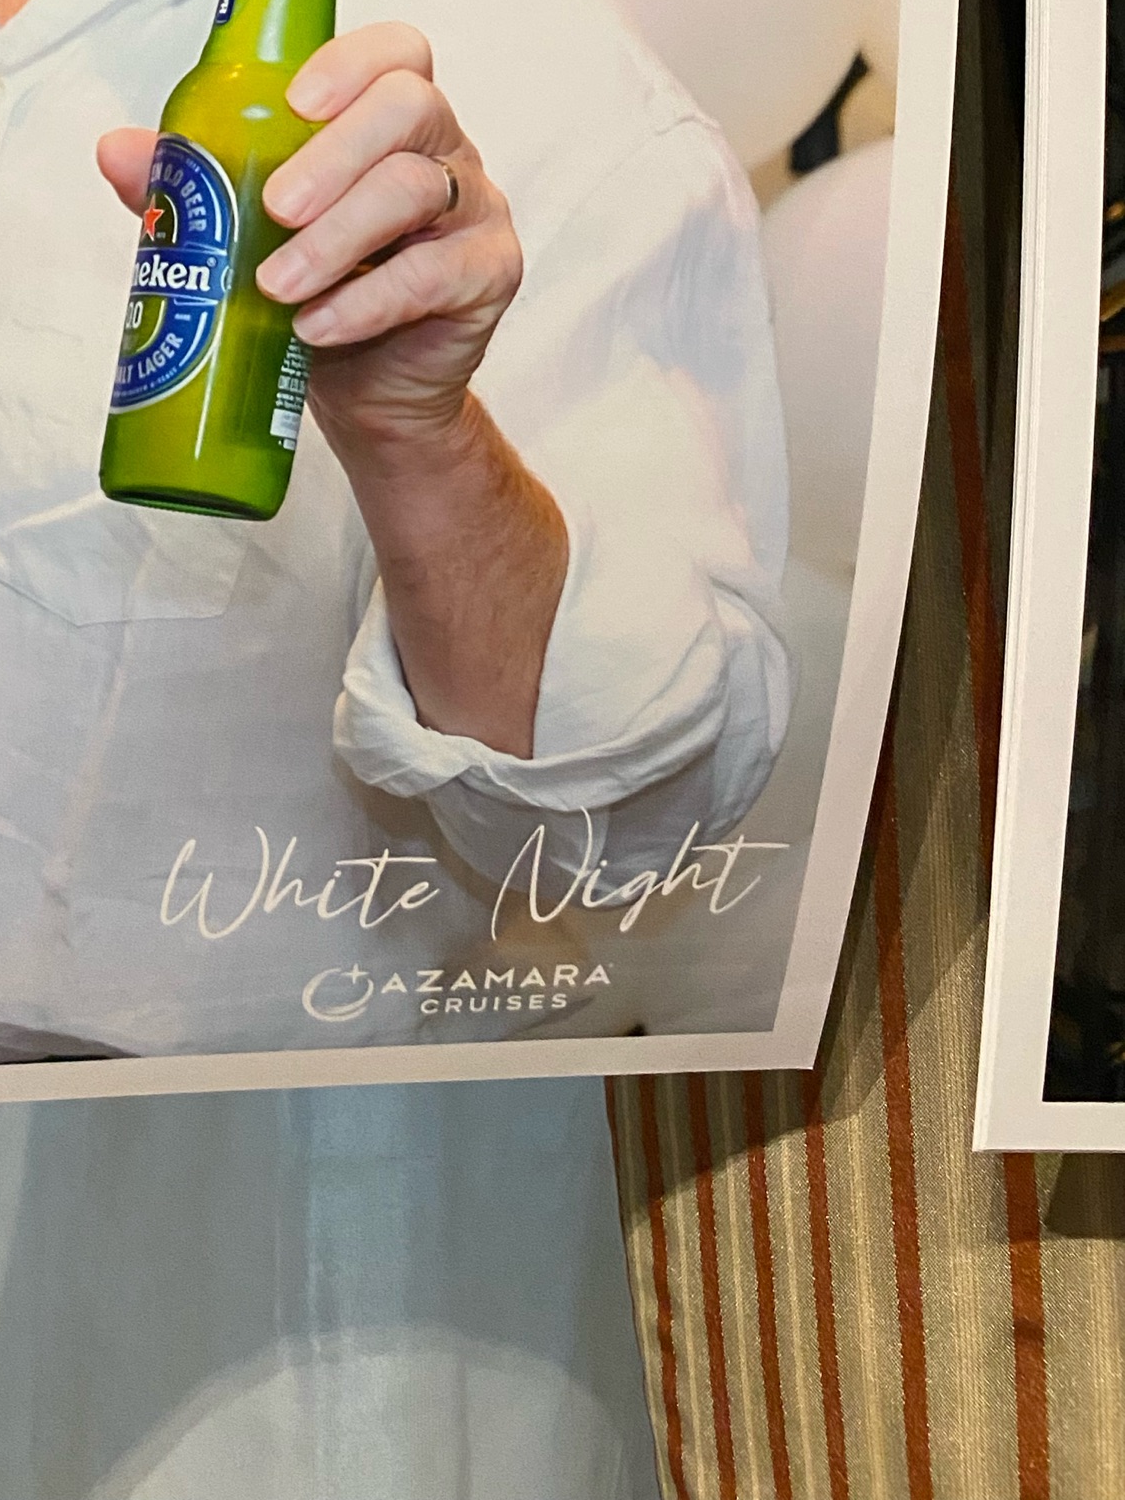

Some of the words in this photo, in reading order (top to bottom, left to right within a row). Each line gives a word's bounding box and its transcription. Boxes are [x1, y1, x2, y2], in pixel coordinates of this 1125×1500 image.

[180, 179, 208, 232] BEER
[137, 332, 185, 379] LAGER
[159, 825, 440, 940] White
[490, 805, 790, 942] Night
[381, 963, 612, 994] AZAMARA
[420, 993, 568, 1015] CRUISES
